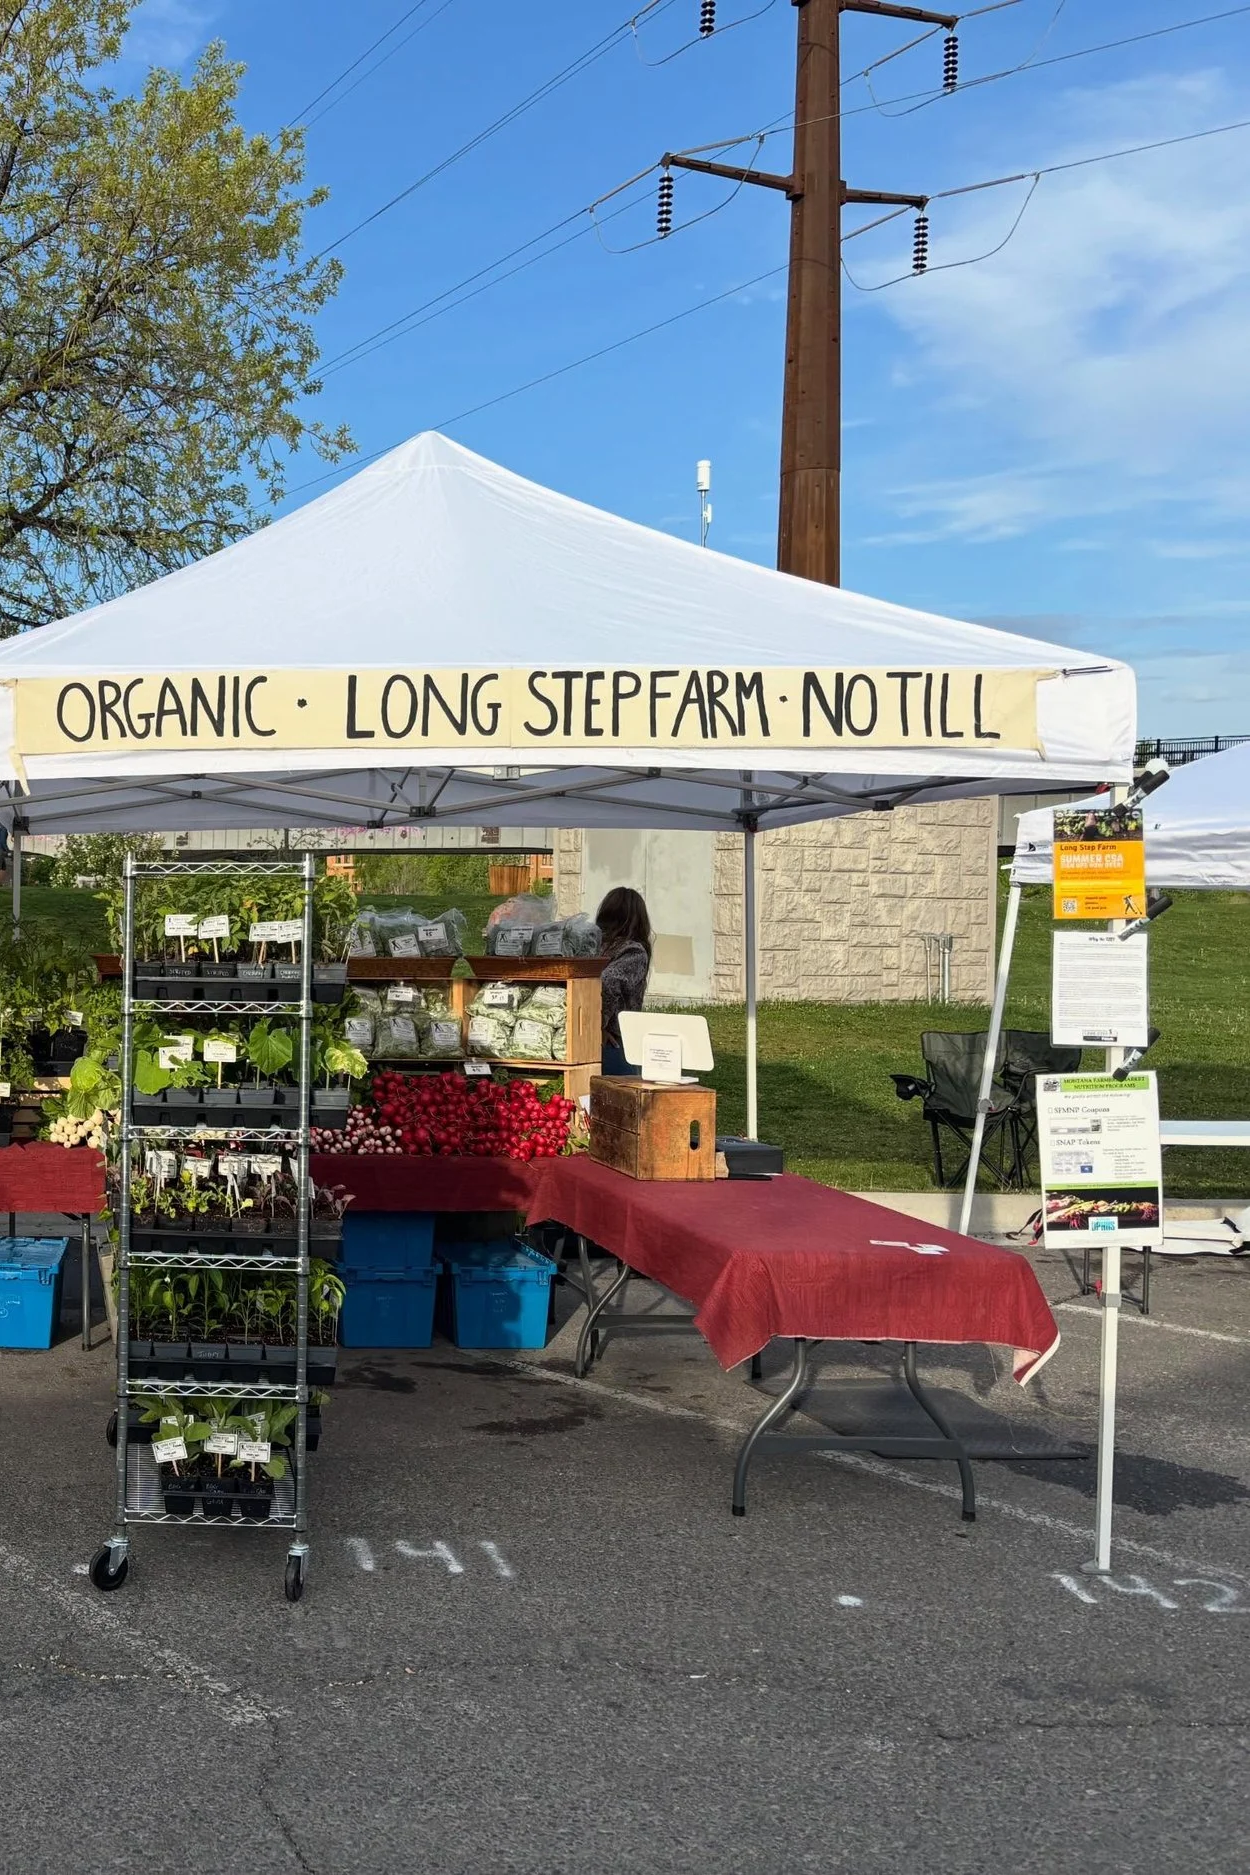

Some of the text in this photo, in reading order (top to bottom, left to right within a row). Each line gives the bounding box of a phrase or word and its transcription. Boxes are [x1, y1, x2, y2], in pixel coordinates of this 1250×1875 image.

[57, 676, 276, 743] ORGANIC
[347, 673, 501, 739] LONG
[1060, 843, 1117, 852] Long Step Farm
[1060, 854, 1124, 863] SUMMER CSA
[1081, 1105, 1110, 1115] Coupons
[1077, 1138, 1101, 1146] Tokens
[344, 1536, 518, 1578] 141
